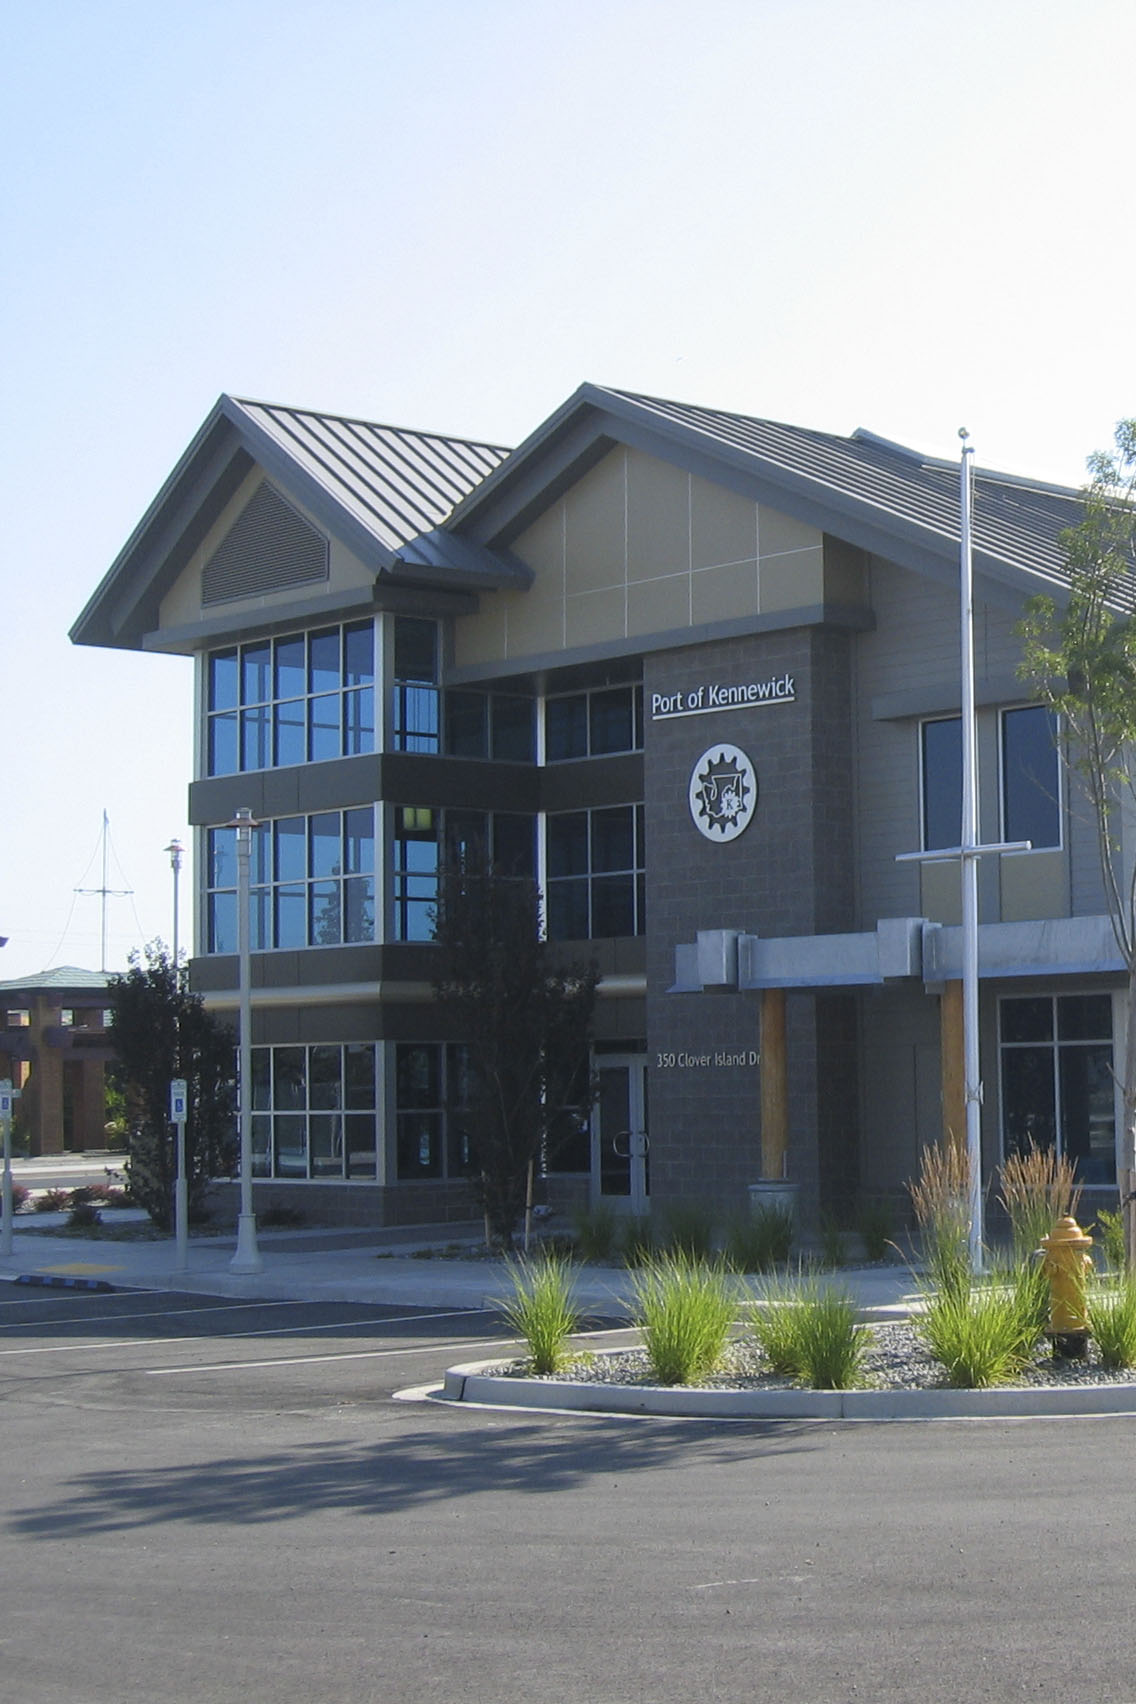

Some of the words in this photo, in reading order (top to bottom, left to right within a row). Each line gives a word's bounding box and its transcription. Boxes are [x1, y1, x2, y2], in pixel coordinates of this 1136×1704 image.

[652, 693, 683, 714] Port
[688, 686, 704, 708] of
[709, 673, 795, 706] Kennewick
[657, 1053, 676, 1068] 350
[677, 1051, 712, 1067] Clover
[714, 1051, 746, 1066] Island
